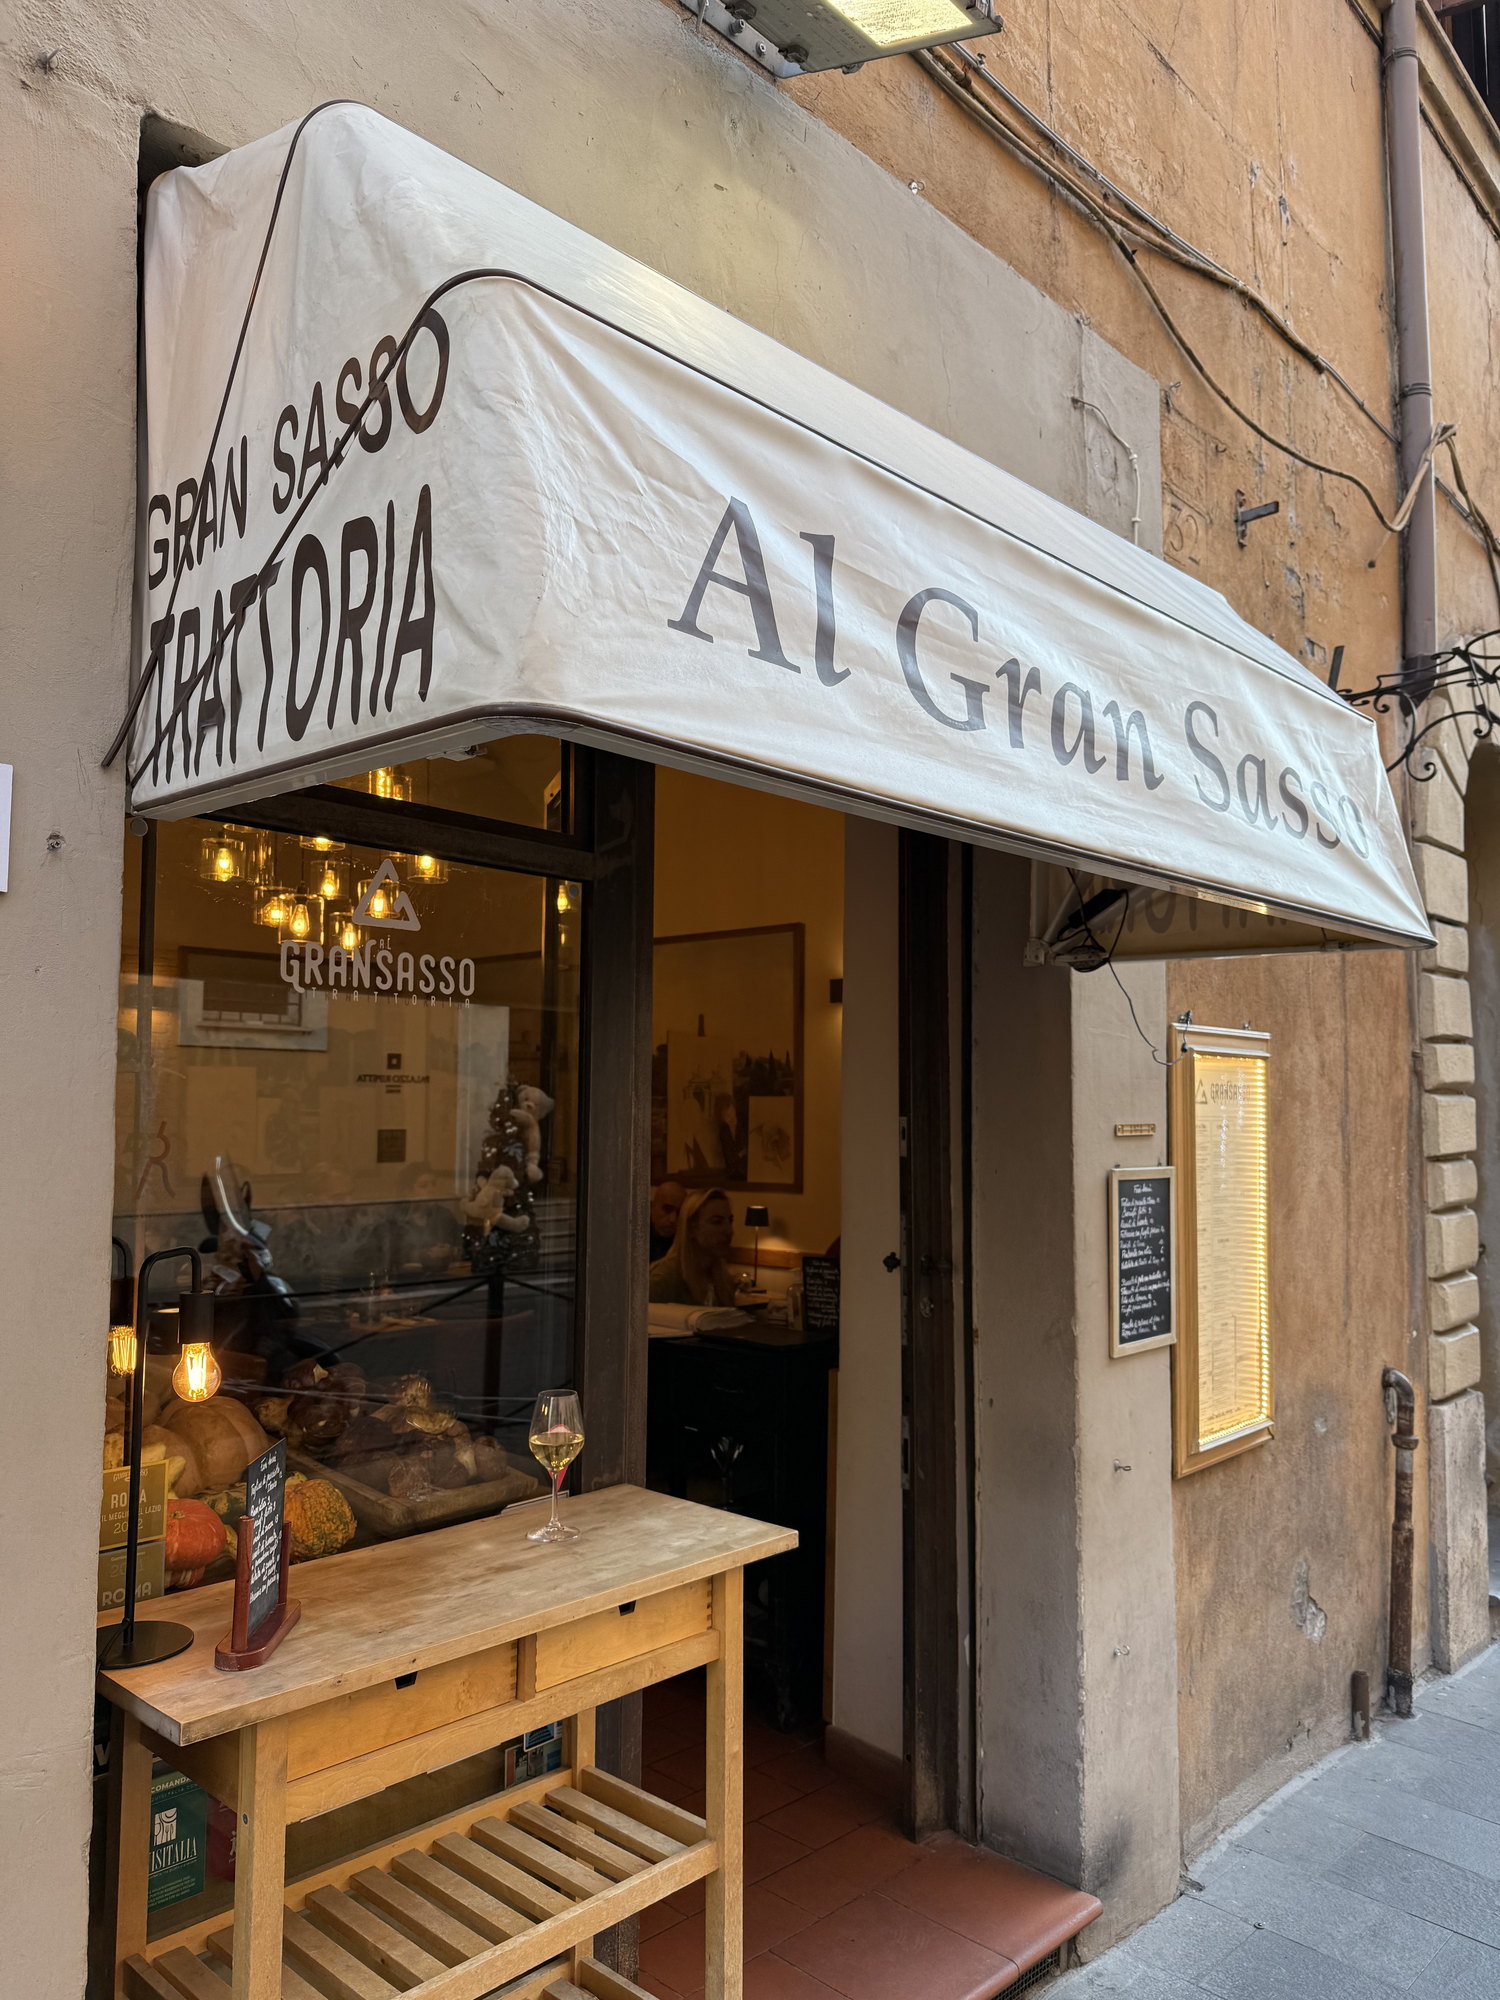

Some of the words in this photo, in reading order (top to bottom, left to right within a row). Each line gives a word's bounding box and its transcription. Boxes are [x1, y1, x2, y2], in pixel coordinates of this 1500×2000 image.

[148, 435, 247, 591] GRAN
[273, 308, 450, 514] SASSO
[150, 484, 436, 787] TRATTORIA
[668, 496, 852, 687] Al
[895, 587, 1165, 792] Gran
[1184, 701, 1371, 860] Sasso
[311, 986, 471, 1009] TRATTORIA
[111, 1489, 147, 1509] ROA
[114, 1519, 144, 1534] 202
[149, 1836, 198, 1872] ISITALIA
